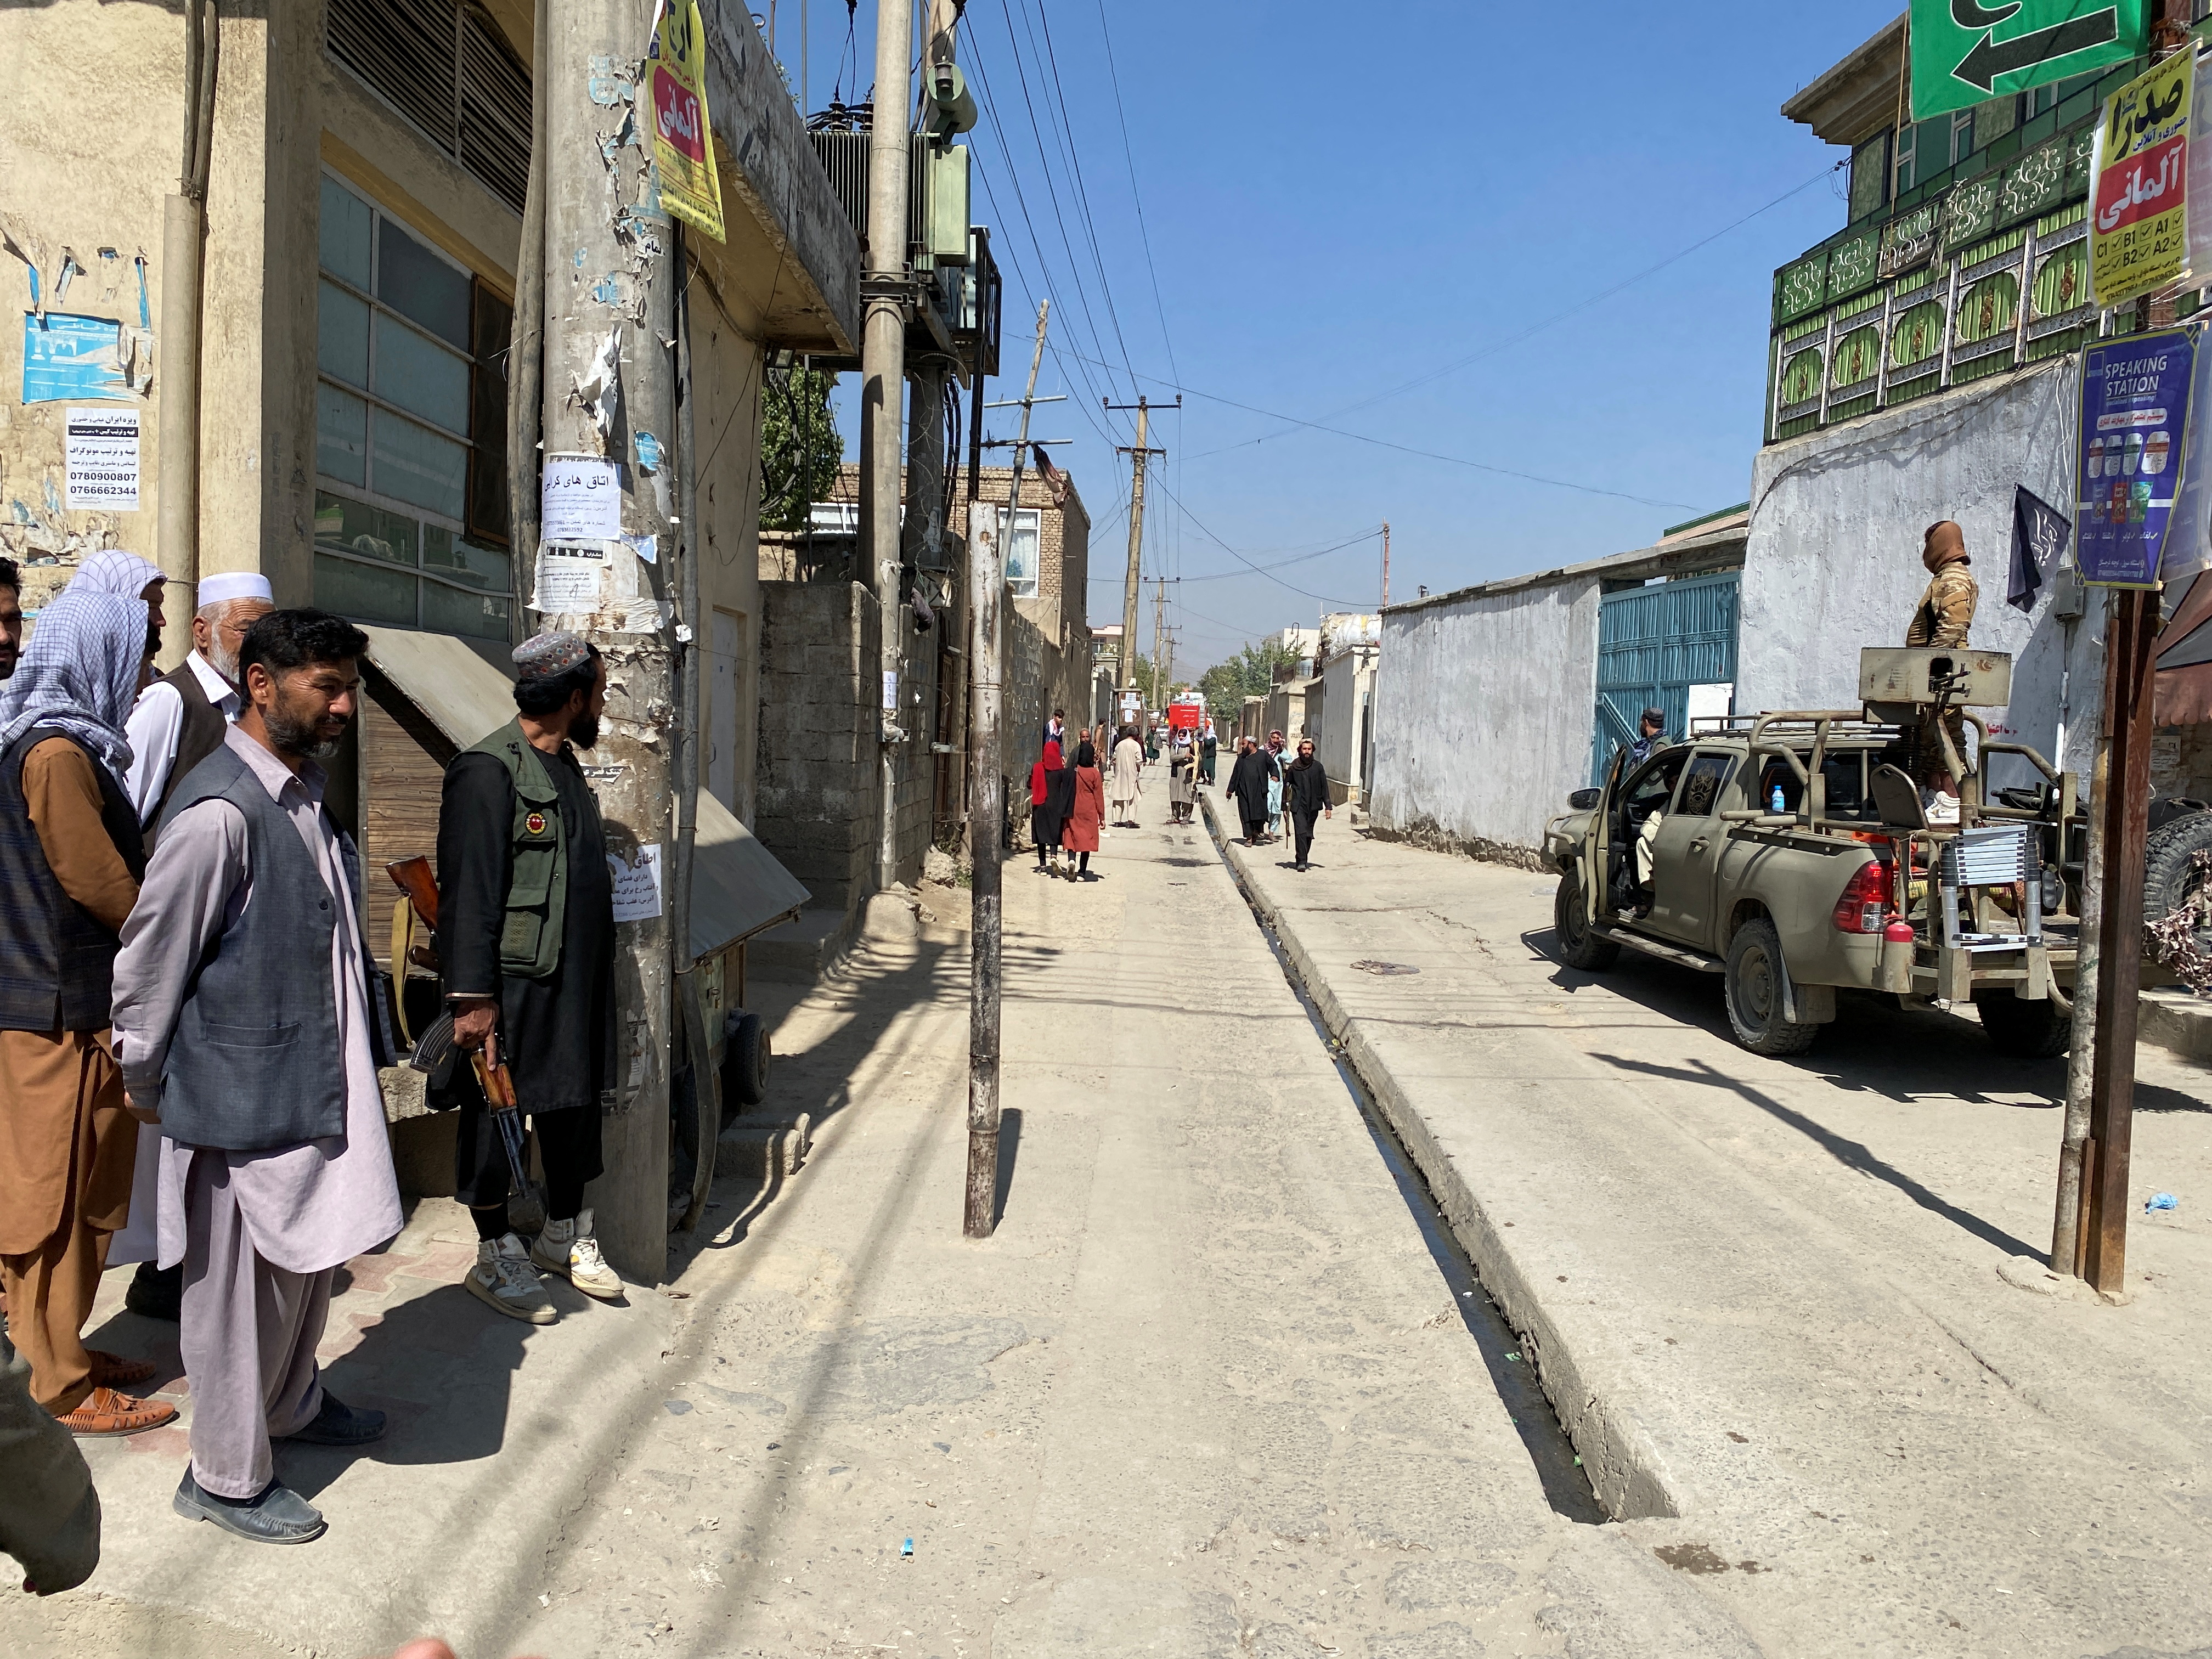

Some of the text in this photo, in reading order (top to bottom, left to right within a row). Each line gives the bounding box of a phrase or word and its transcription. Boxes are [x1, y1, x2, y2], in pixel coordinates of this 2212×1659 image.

[658, 83, 698, 144] آلمانی
[2163, 116, 2188, 137] حضوری
[2132, 127, 2157, 153] آنلاین
[2098, 142, 2184, 230] آلمانی
[2097, 217, 2169, 258] C1 B1 A1
[2123, 236, 2170, 267] B2 A2
[2106, 355, 2168, 380] SPEAKING
[2107, 375, 2159, 397] STATION
[100, 448, 118, 456] ترتیب
[70, 472, 137, 481] 0780900807
[563, 474, 581, 488] های
[586, 475, 609, 489] اتاق
[70, 486, 137, 495] 0766662344
[634, 851, 657, 870] اطاق
[633, 873, 648, 882] دارای
[621, 887, 634, 895] برای
